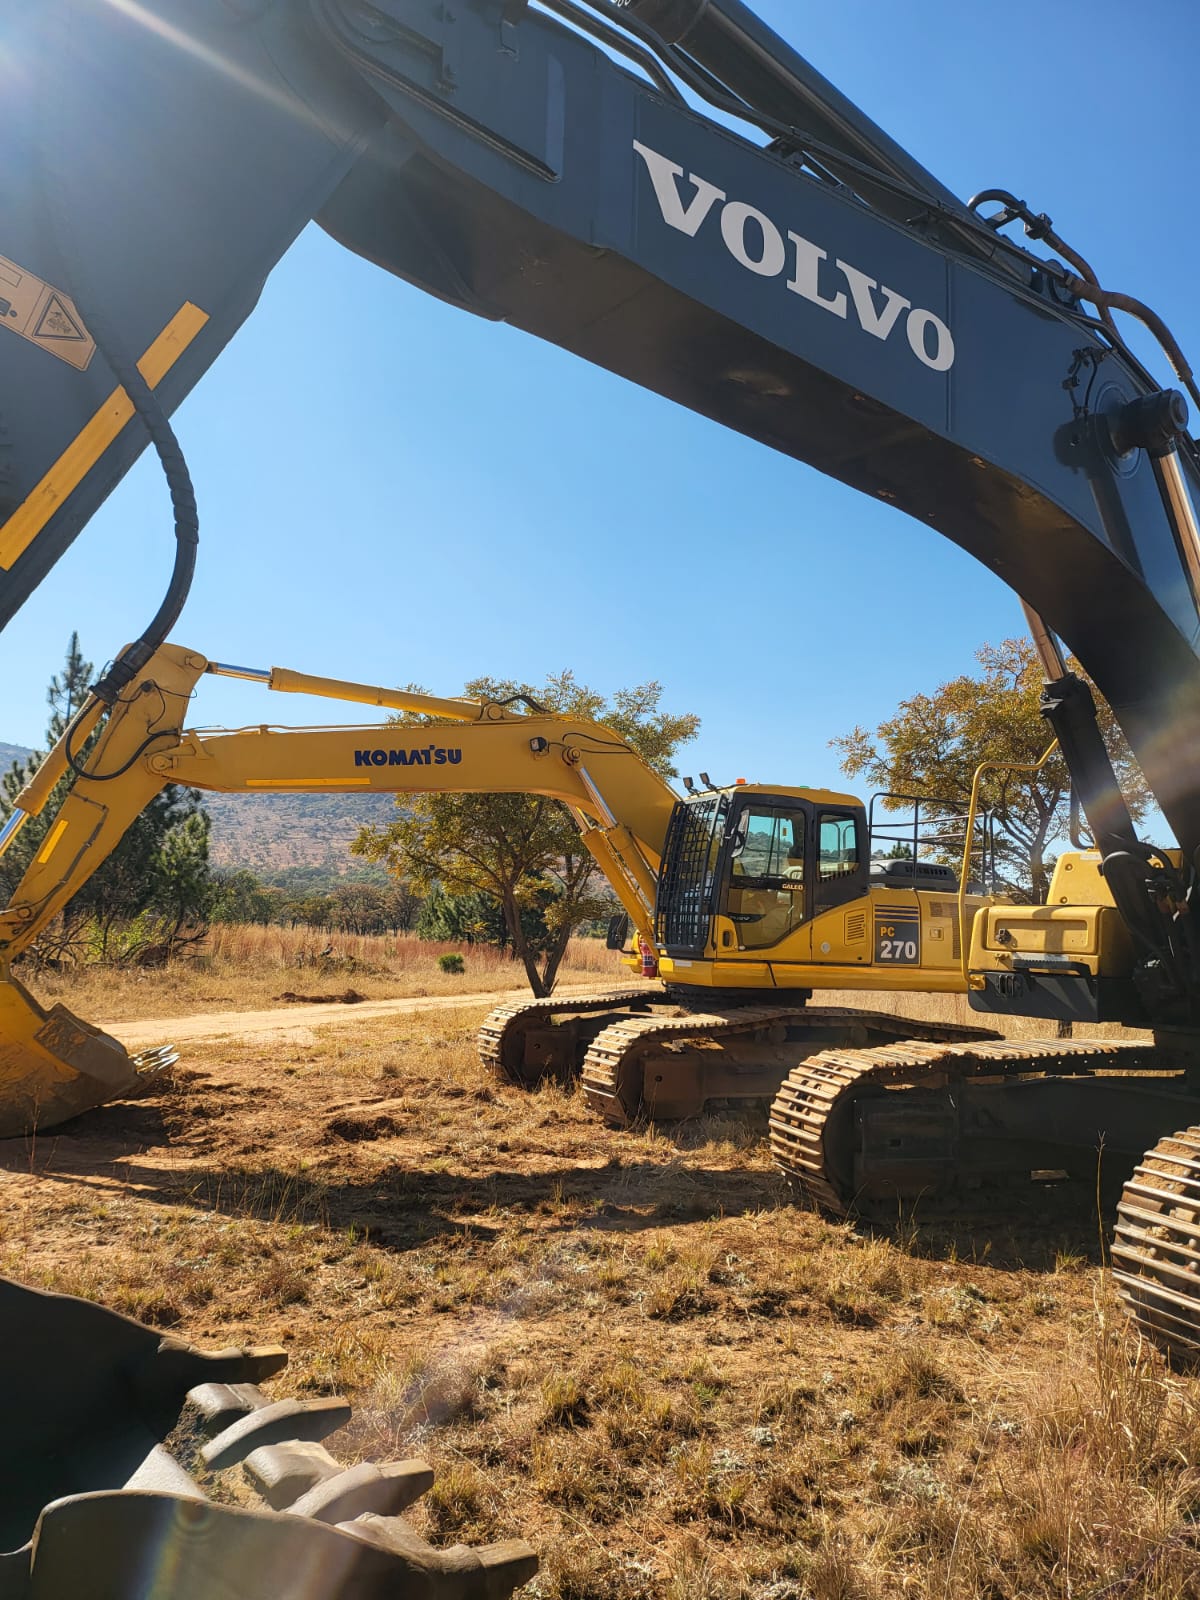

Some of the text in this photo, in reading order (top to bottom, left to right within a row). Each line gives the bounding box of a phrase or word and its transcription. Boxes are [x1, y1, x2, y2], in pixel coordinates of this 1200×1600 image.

[633, 139, 955, 371] VOLVO
[354, 745, 462, 766] KOMATSU
[880, 926, 895, 937] PC
[880, 940, 917, 959] 270
